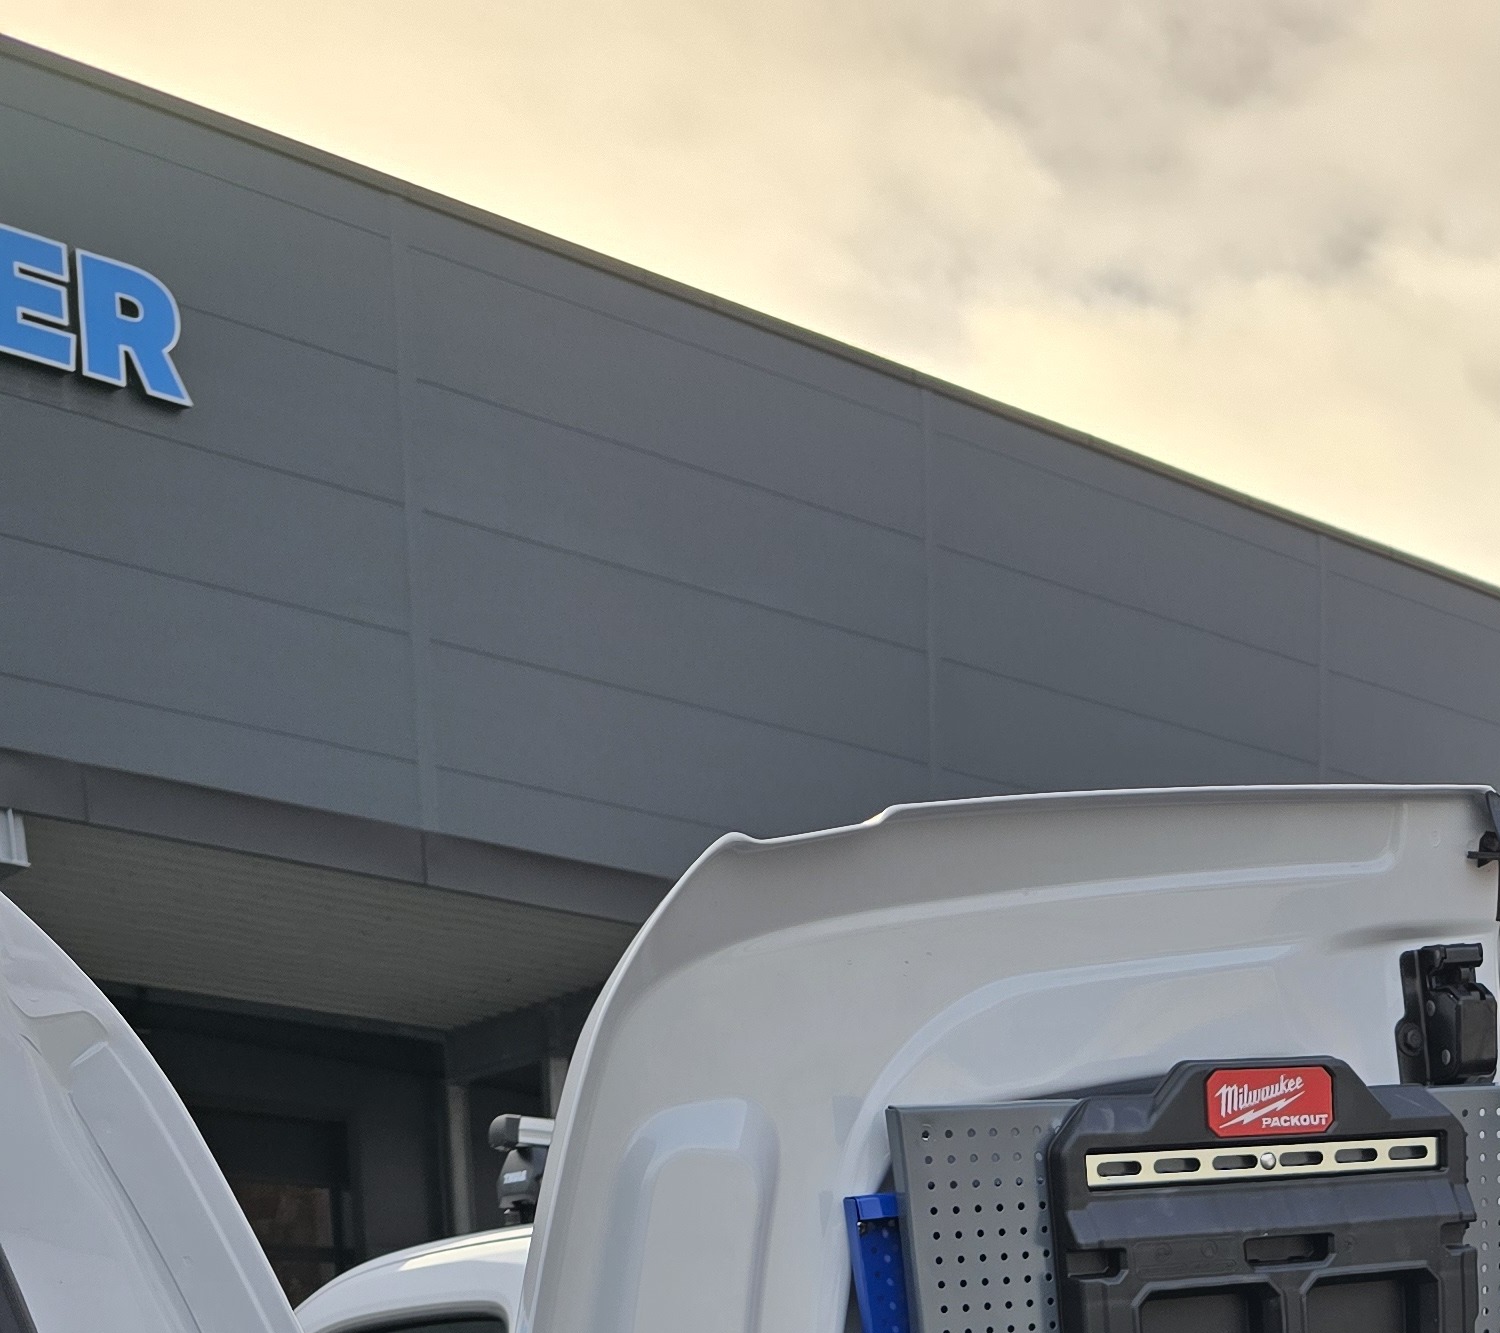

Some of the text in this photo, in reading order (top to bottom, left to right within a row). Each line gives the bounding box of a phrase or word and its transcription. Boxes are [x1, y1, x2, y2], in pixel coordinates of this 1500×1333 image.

[0, 223, 194, 407] ER
[1214, 1073, 1305, 1118] Milwaukee
[1261, 1113, 1329, 1129] PACKOUT
